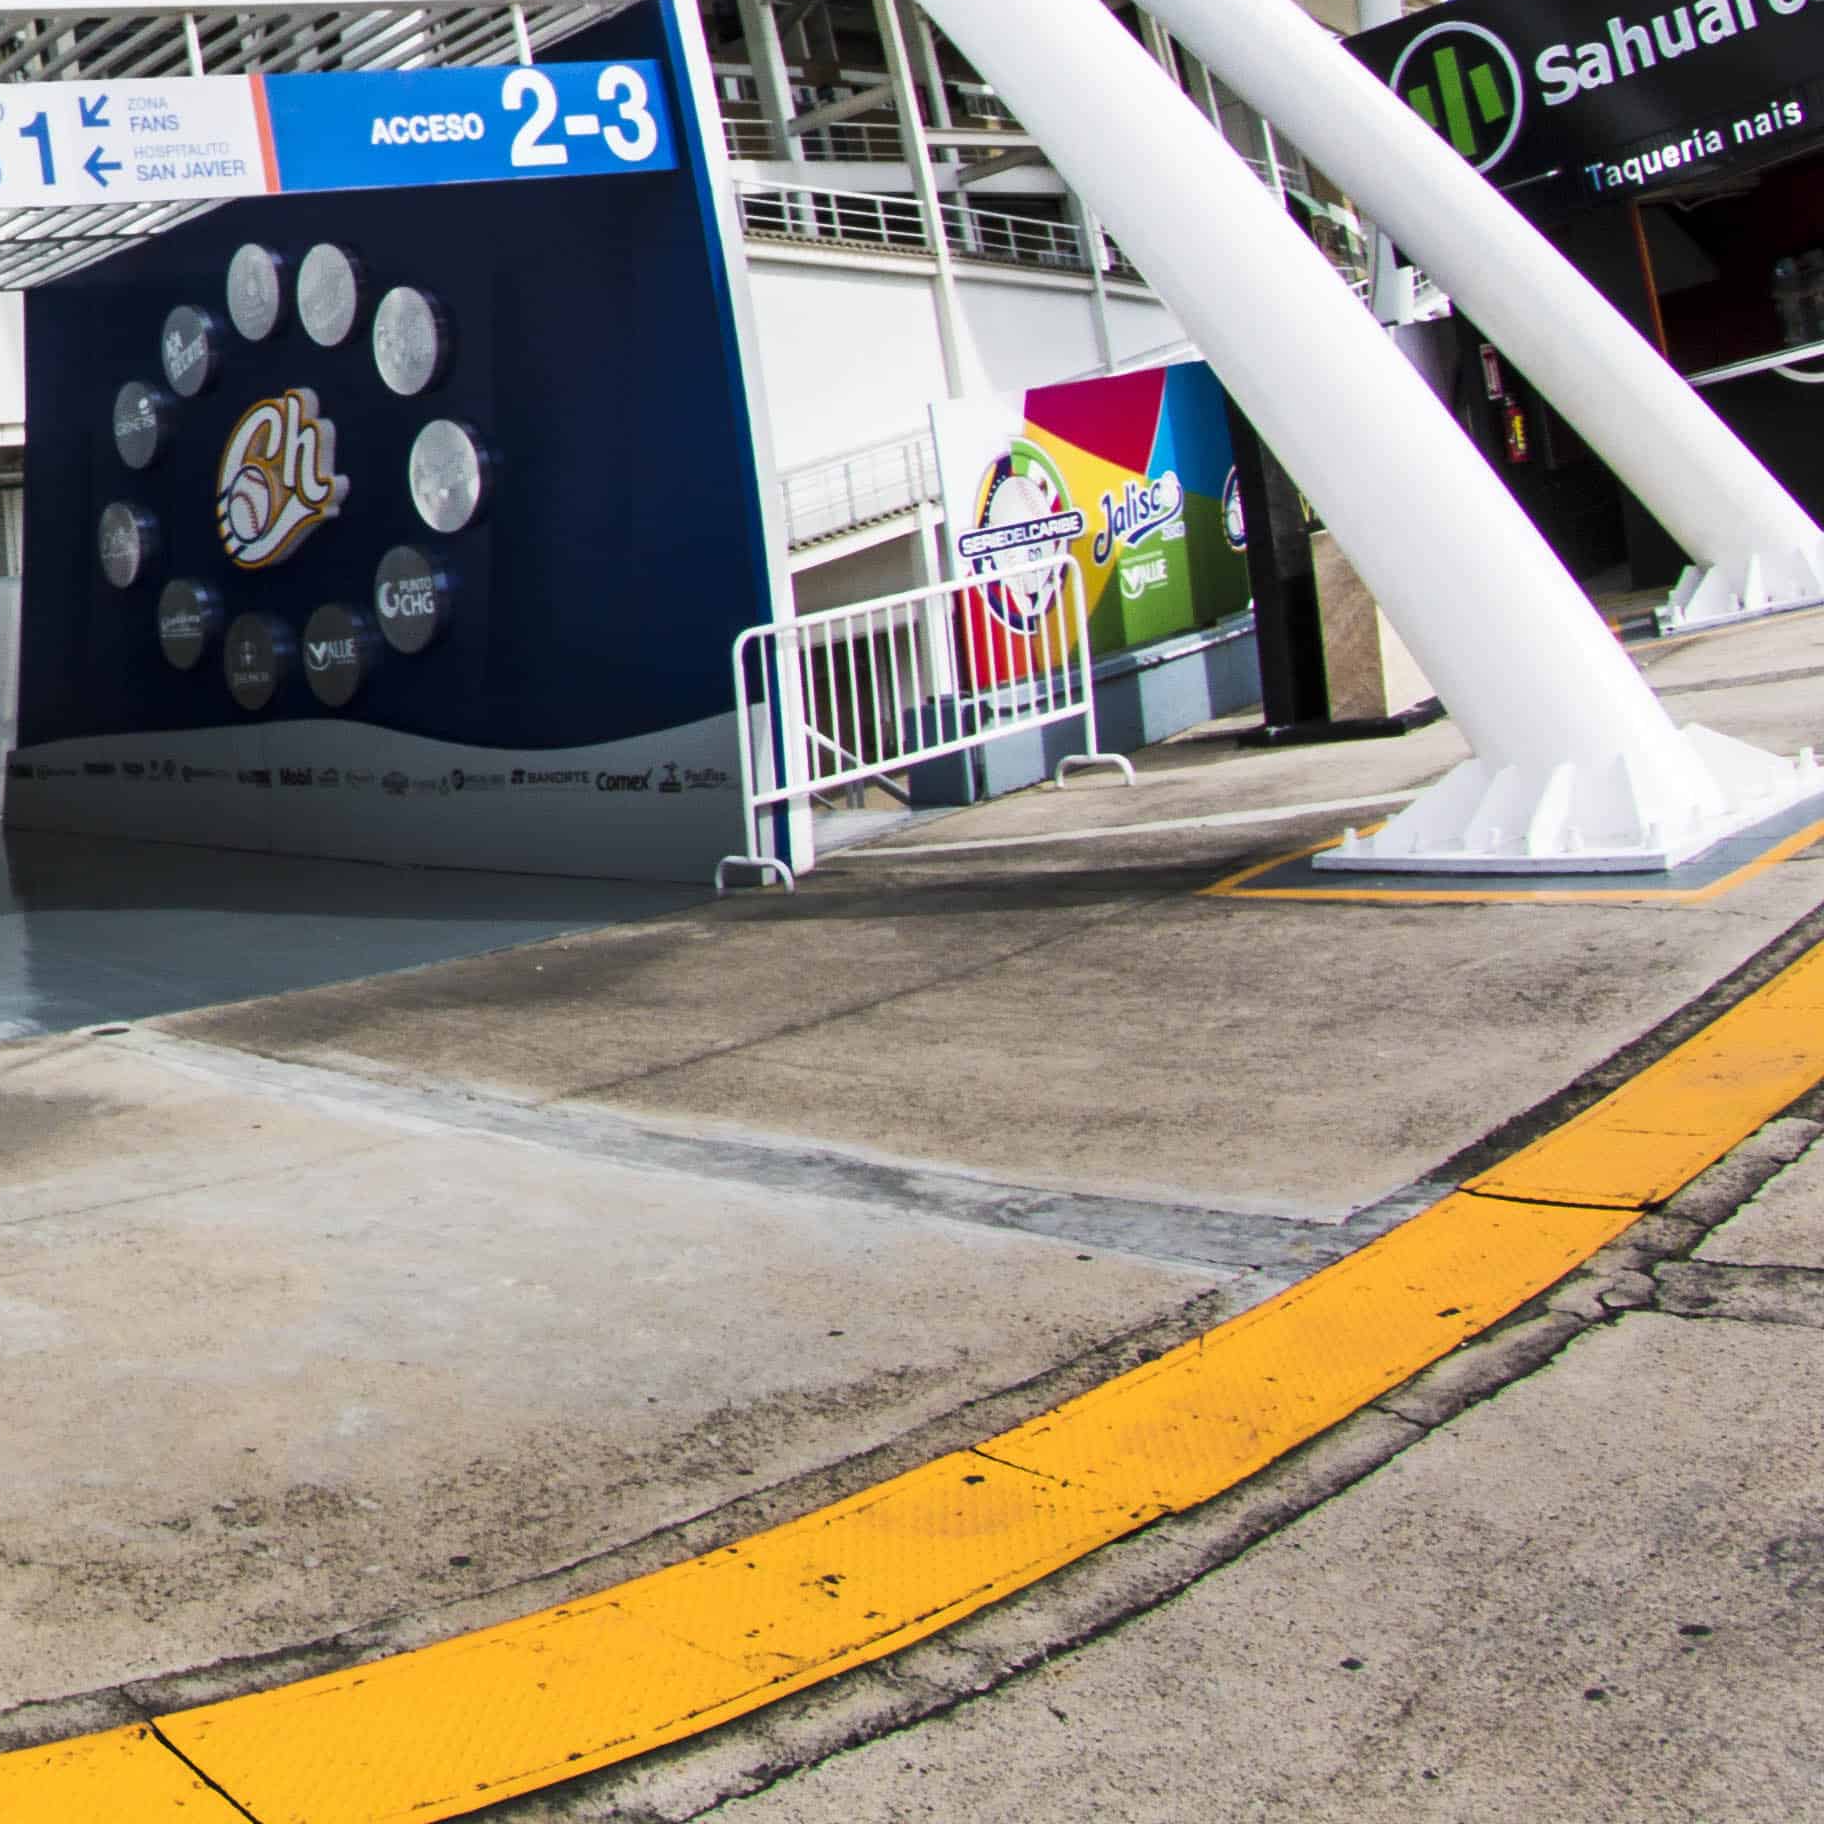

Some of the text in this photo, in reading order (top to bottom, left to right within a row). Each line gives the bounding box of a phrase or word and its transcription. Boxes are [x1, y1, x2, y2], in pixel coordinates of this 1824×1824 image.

[129, 114, 180, 133] FANS
[371, 64, 657, 169] ACCESO 2-3
[19, 111, 56, 185] 1
[136, 159, 246, 182] SAN JAVIER
[1585, 100, 1803, 192] Taquería nais
[401, 591, 435, 617] CHG
